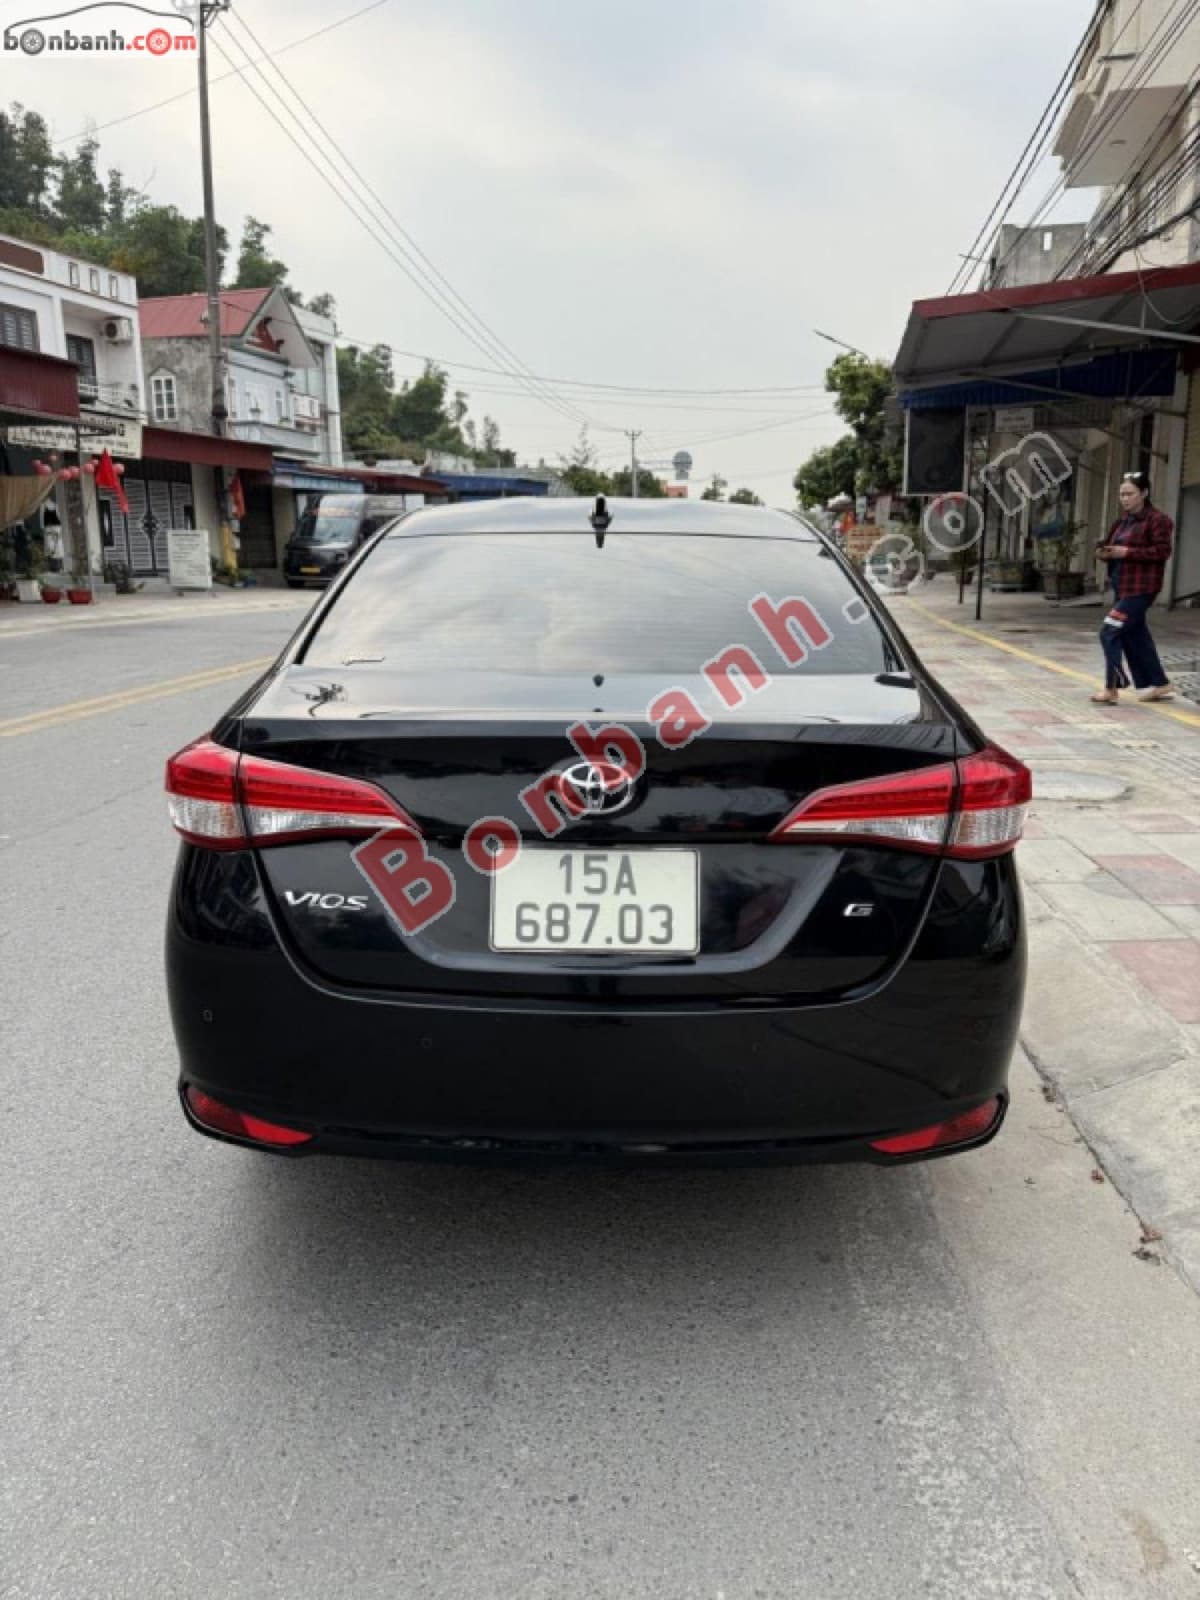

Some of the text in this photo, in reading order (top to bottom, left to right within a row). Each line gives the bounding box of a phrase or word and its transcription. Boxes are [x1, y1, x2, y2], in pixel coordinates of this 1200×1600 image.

[559, 853, 637, 896] 15A
[284, 891, 369, 911] VIOS
[843, 903, 874, 917] G
[515, 902, 673, 945] 687.03
